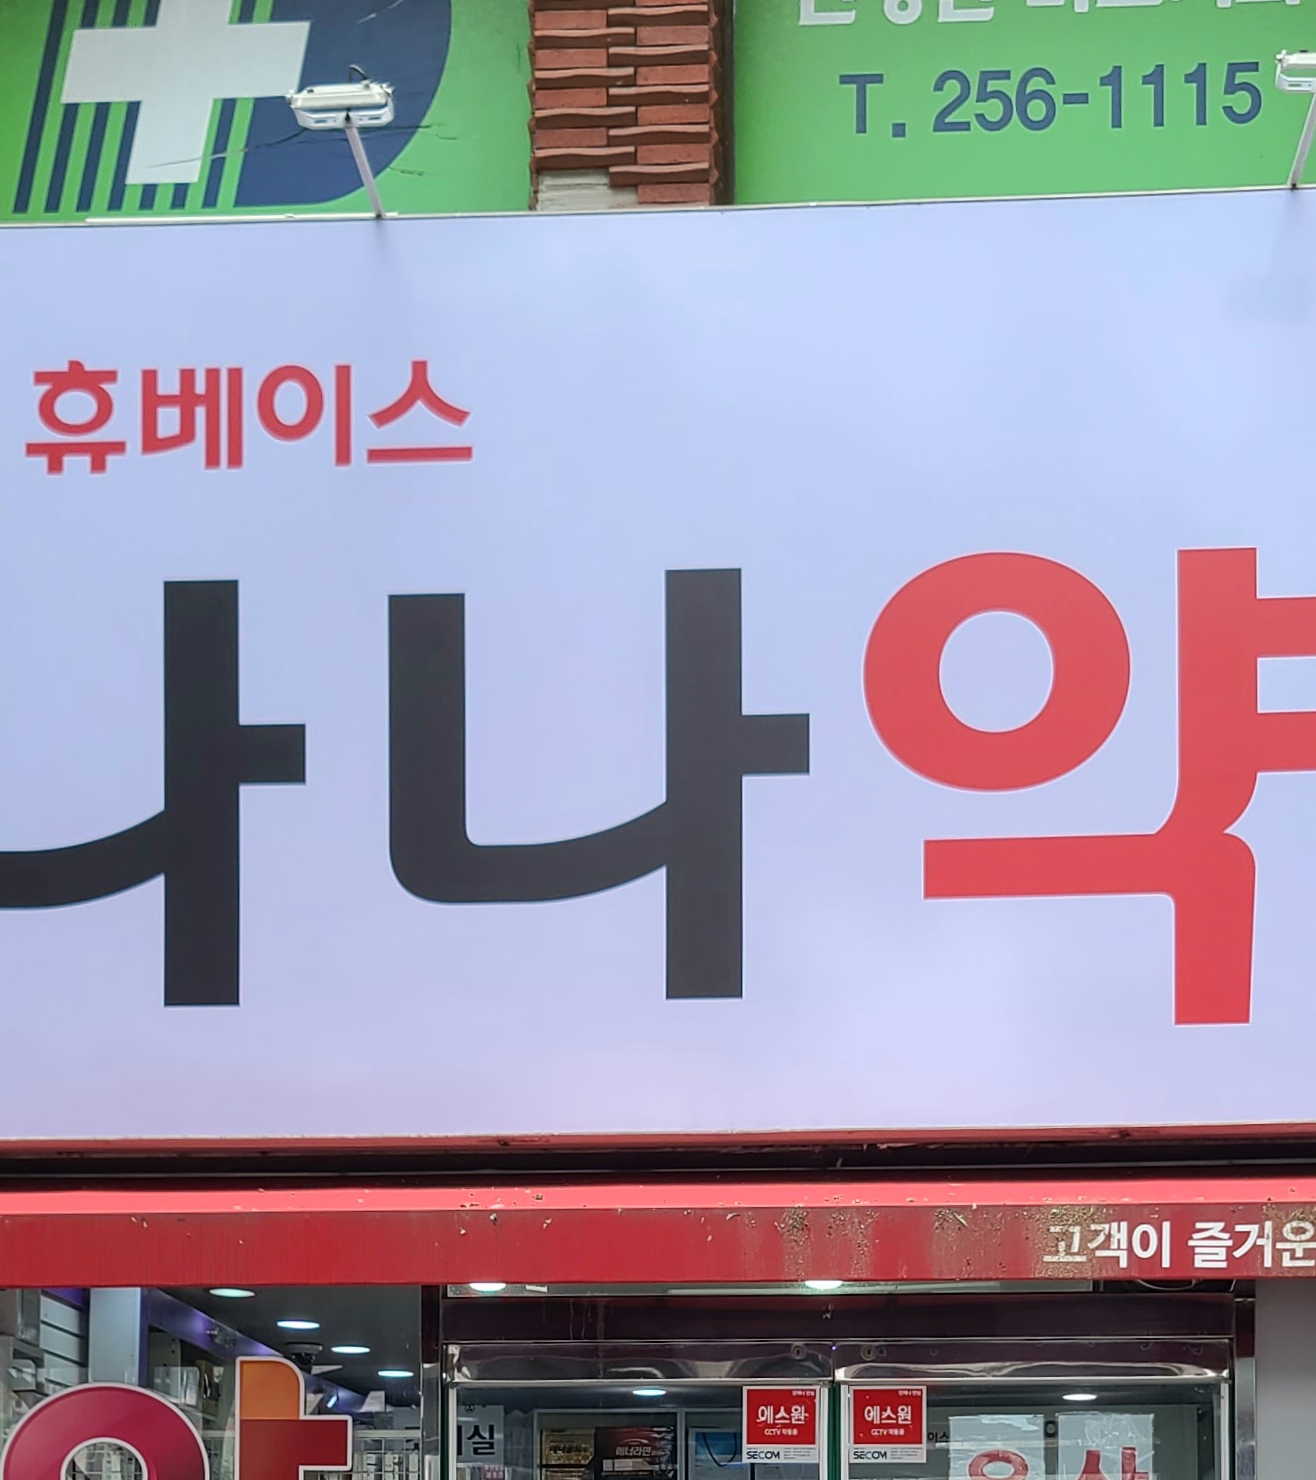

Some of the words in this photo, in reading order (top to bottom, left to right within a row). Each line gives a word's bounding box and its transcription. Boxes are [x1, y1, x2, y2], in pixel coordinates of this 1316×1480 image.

[838, 73, 907, 138] T.
[931, 61, 1263, 133] 256-1115
[25, 359, 474, 476] 휴베이스
[1042, 1221, 1171, 1269] 고객이
[758, 1405, 806, 1425] 에스원
[864, 1405, 913, 1425] 에스원
[746, 1450, 781, 1460] SECOM
[853, 1450, 888, 1460] SECOM
